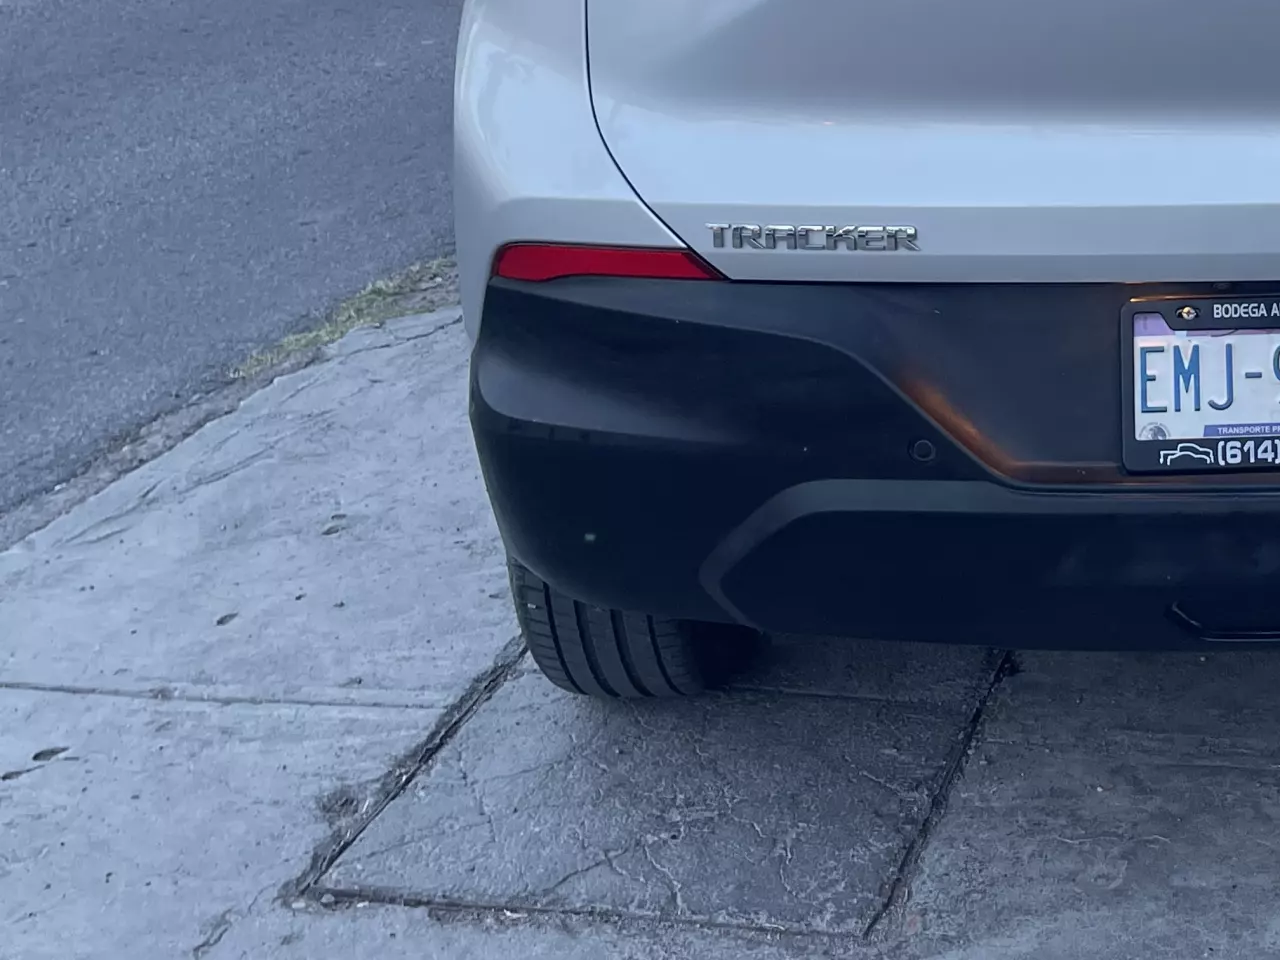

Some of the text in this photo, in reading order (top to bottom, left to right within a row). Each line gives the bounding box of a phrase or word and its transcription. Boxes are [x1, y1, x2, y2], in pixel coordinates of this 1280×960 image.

[705, 222, 921, 251] TRACKER
[1213, 302, 1268, 318] BODEGA
[1217, 425, 1271, 435] TRANSPORTE
